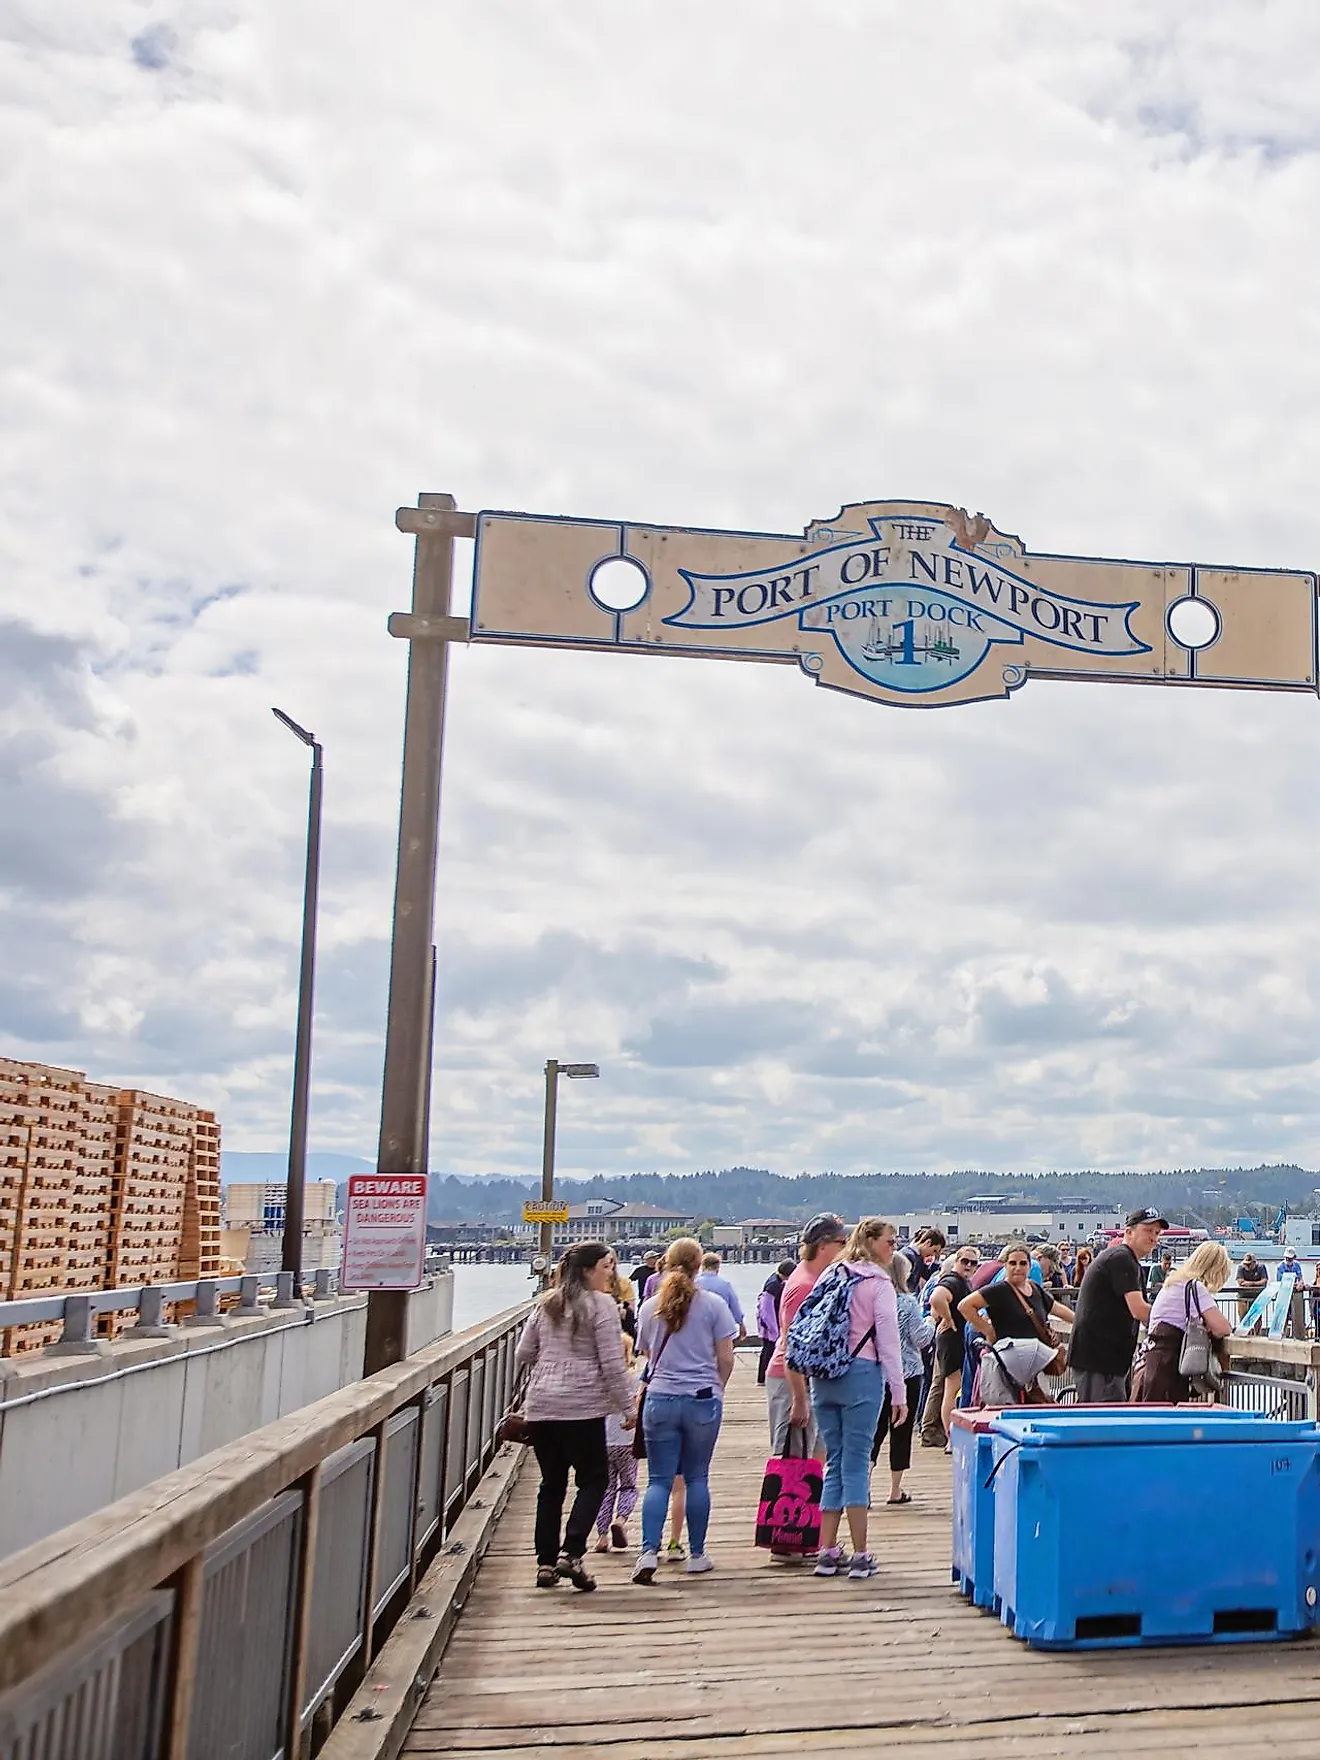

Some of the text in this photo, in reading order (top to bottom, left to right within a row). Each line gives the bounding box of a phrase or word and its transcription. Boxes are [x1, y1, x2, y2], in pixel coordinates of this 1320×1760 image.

[891, 523, 937, 542] THE
[710, 546, 1109, 644] PORT OF NEWPORT
[825, 599, 987, 633] PORT DOCK
[892, 619, 922, 666] 1
[353, 1180, 422, 1194] BEWARE
[352, 1199, 421, 1210] SEA LIONS ARE
[524, 1200, 567, 1211] CAUTION
[356, 1213, 416, 1223] DANGEROUS
